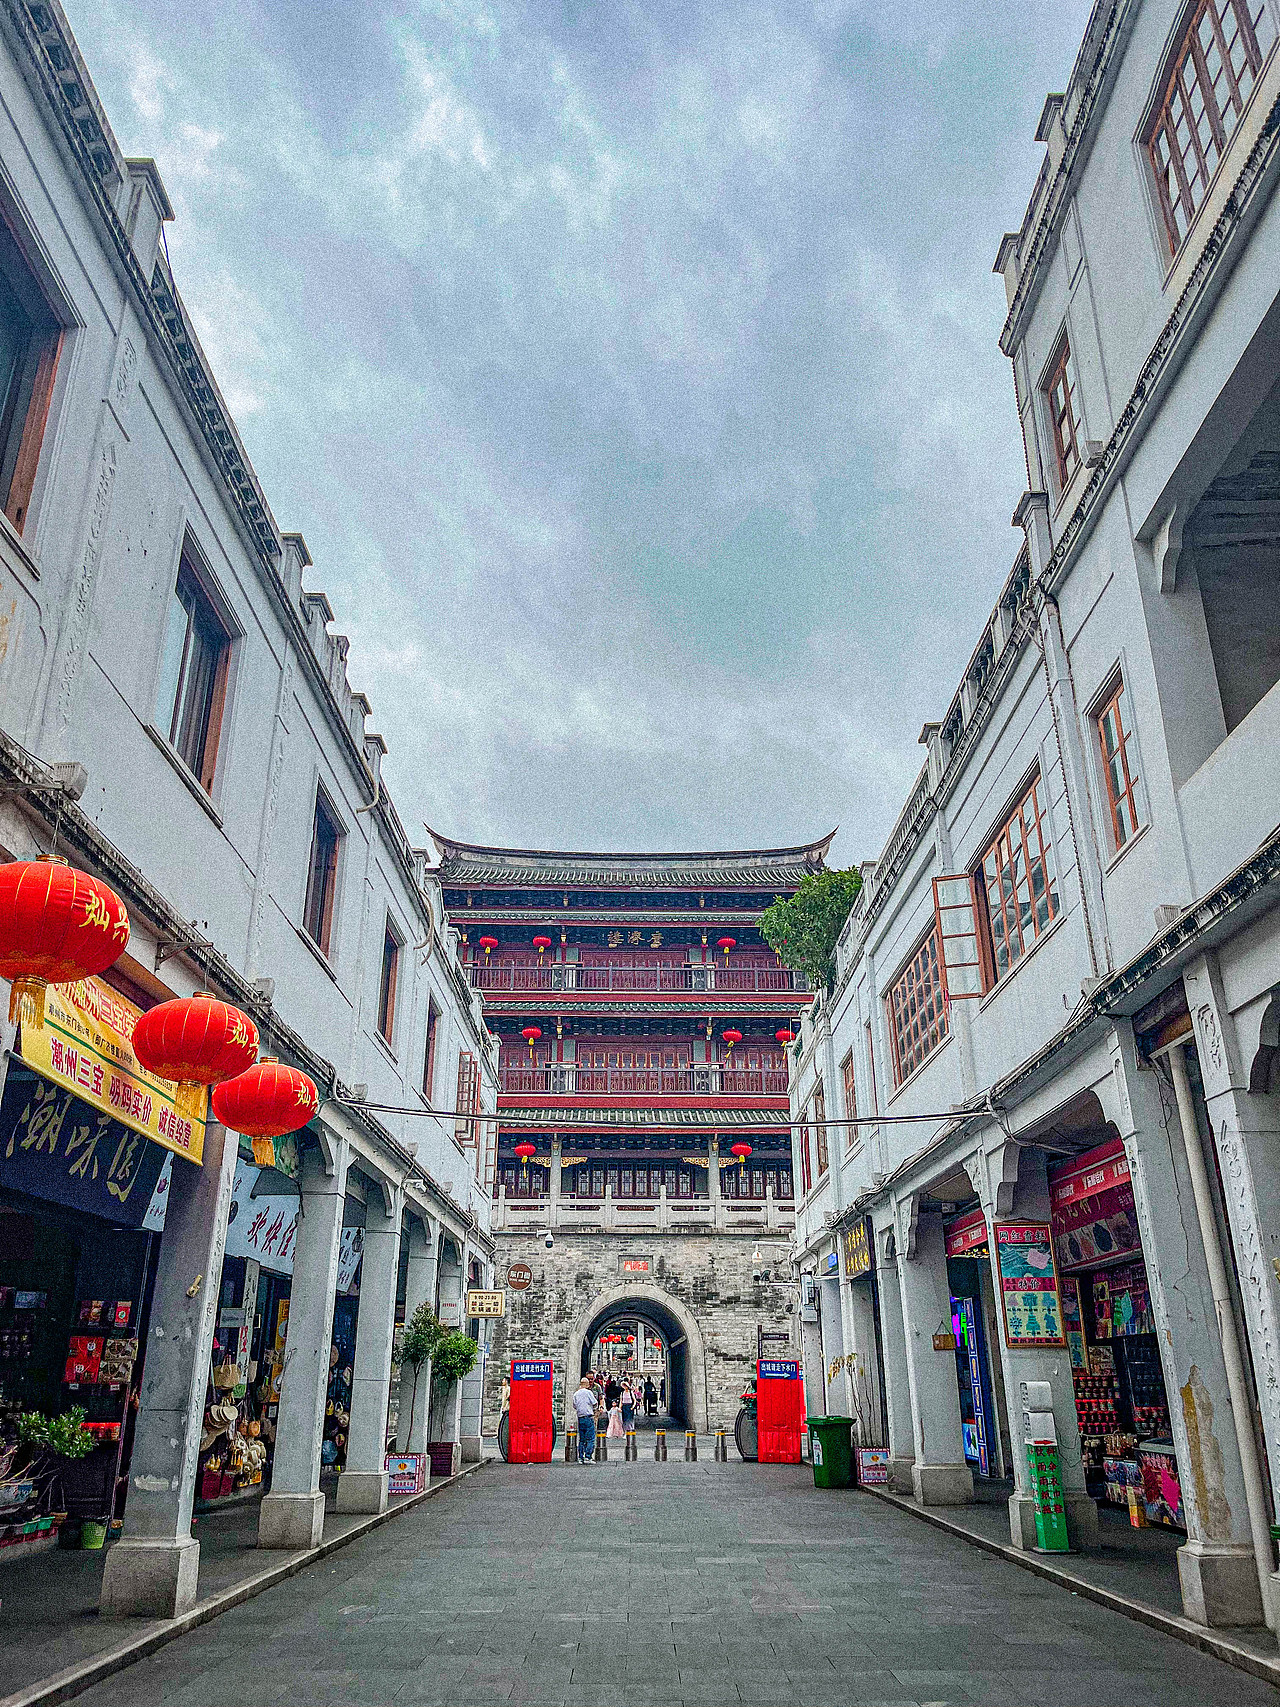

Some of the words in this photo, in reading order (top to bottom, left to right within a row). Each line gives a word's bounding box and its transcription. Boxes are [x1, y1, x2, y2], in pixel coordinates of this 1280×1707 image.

[50, 1037, 106, 1098] 潮州三宝
[109, 1074, 153, 1127] 明码实价
[157, 1104, 193, 1150] 诚信经营
[999, 1230, 1048, 1241] 网红雪糕
[1018, 1278, 1041, 1290] 特价
[761, 1362, 796, 1372] 出城请走下水门
[1037, 1461, 1057, 1472] 雨伞
